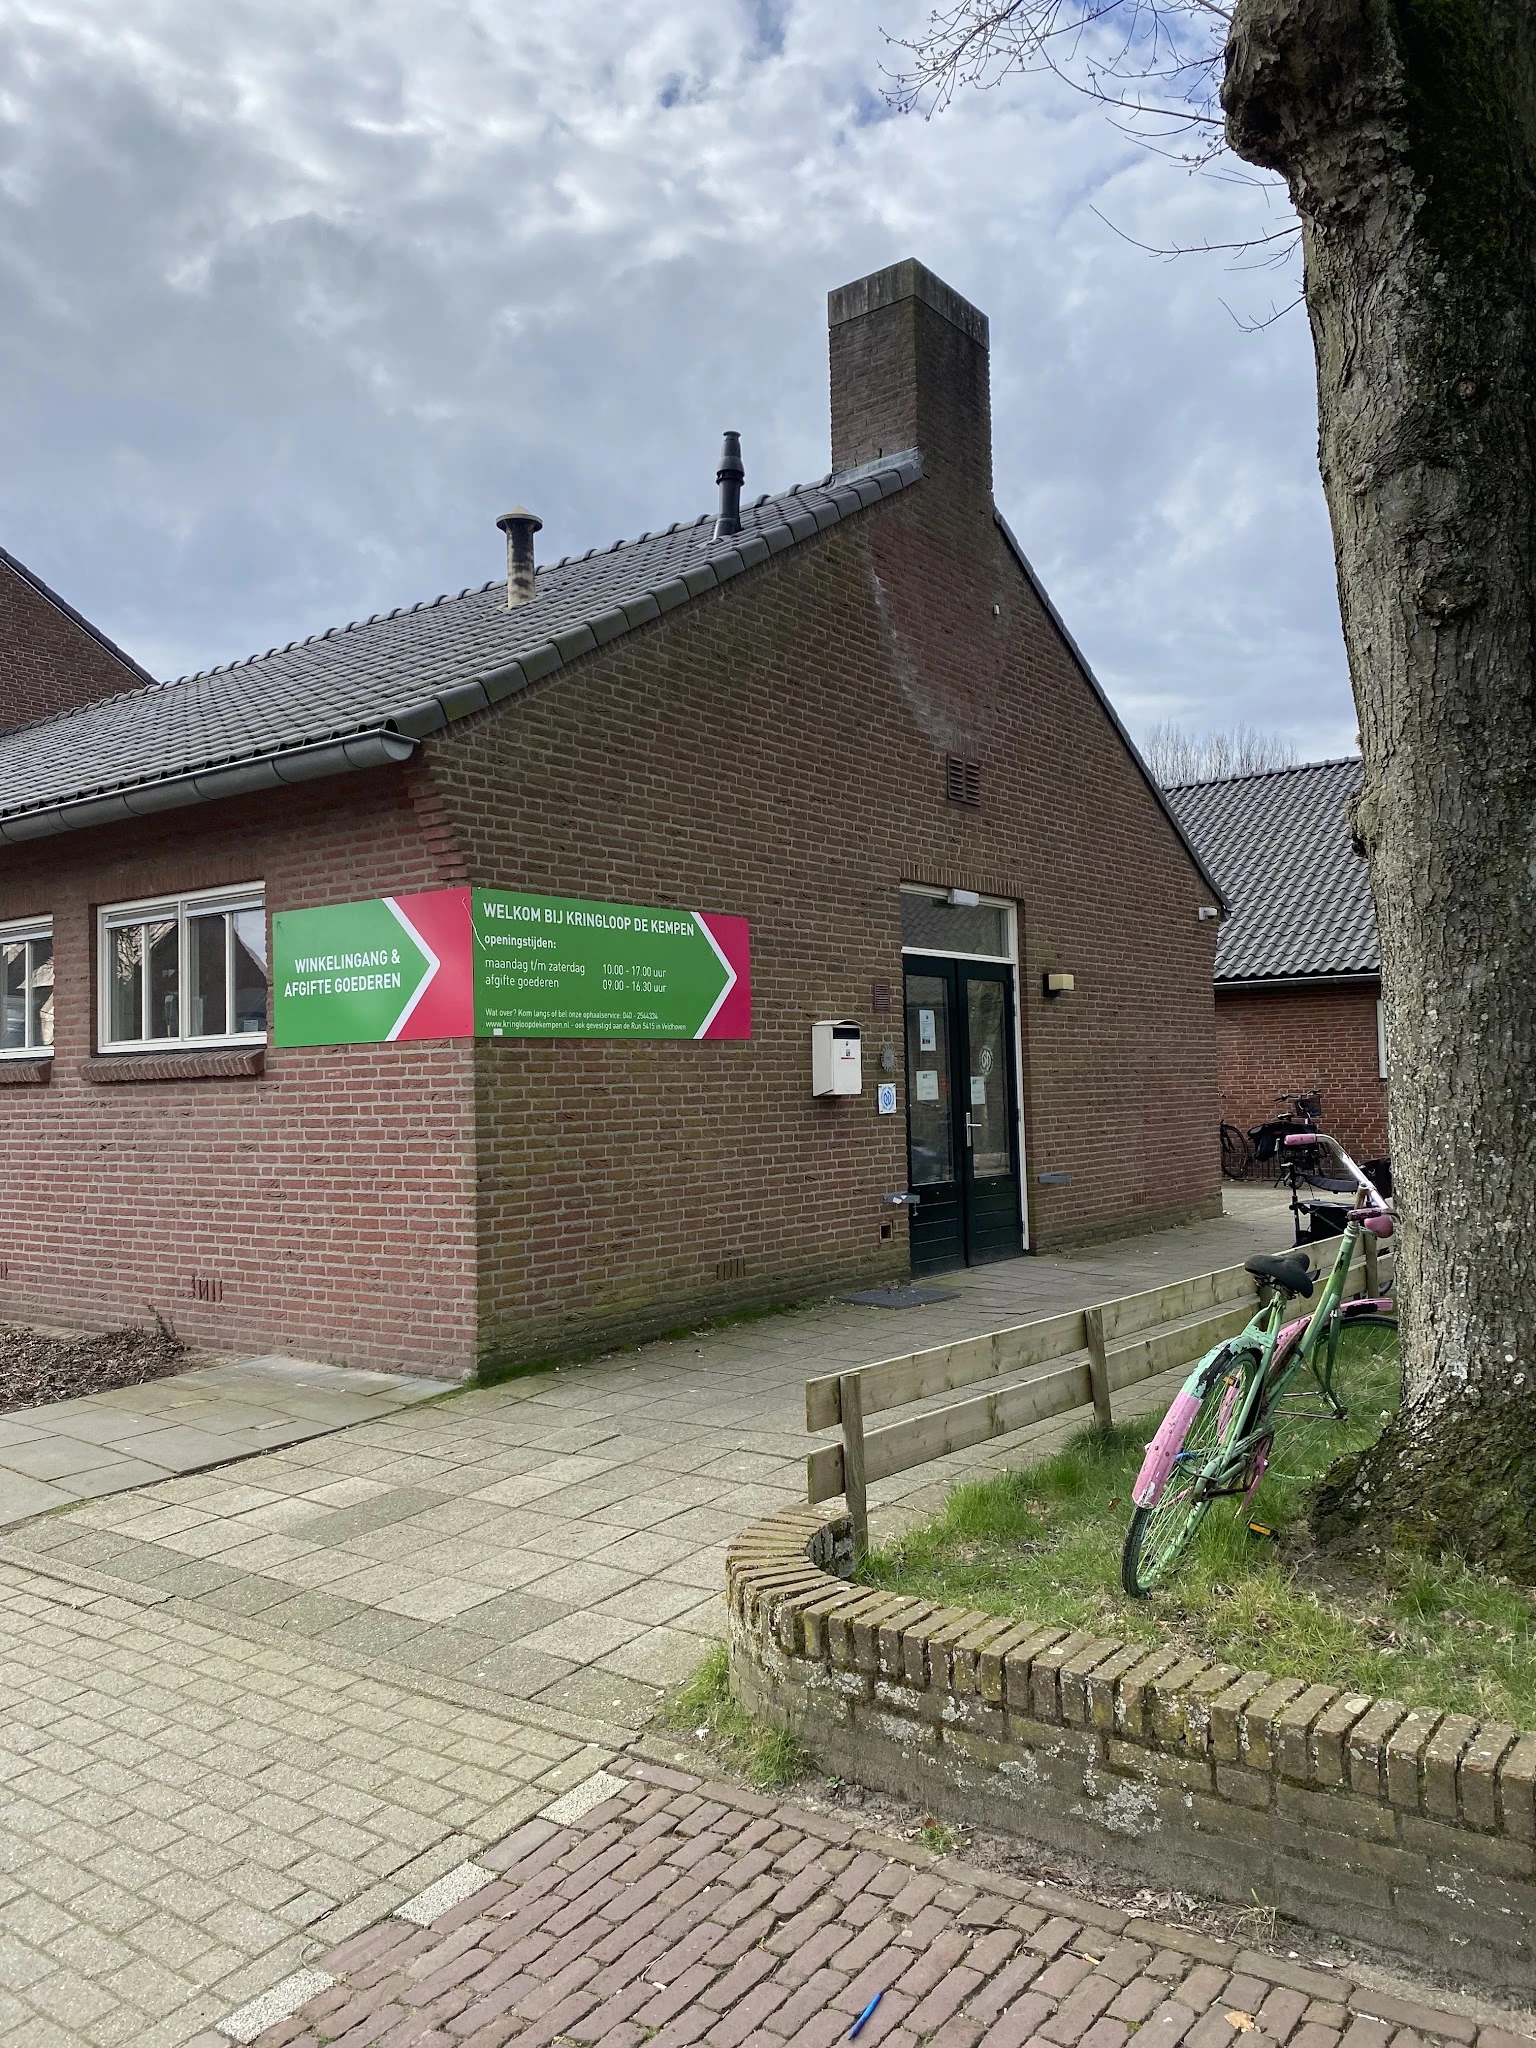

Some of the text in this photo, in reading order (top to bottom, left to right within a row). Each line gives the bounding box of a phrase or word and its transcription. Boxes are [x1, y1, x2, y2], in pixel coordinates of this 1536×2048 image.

[484, 903, 694, 936] WELKOM BIJ KRINGLOOP DE KEMPEN
[484, 934, 556, 950] openingstijden:
[295, 949, 400, 974] WINKELINGANG &
[485, 959, 528, 973] maandag
[530, 960, 546, 972] t/m
[549, 961, 585, 976] zaterdag
[603, 964, 623, 975] 10.00
[631, 966, 652, 977] 17.00
[653, 968, 666, 978] uur
[284, 973, 401, 997] AFGIFTE GOEDEREN
[485, 975, 515, 988] afgifte
[517, 976, 559, 989] goederen
[603, 980, 624, 991] 09.00
[632, 981, 652, 992] 16.30
[653, 984, 667, 993] uur
[485, 1008, 498, 1017] Wat
[500, 1009, 517, 1017] over?
[518, 1009, 532, 1017] Kom
[534, 1009, 550, 1019] langs
[485, 1020, 570, 1030] www.kringloopdekempen.nl
[623, 1022, 630, 1030] de
[631, 1022, 642, 1030] Run
